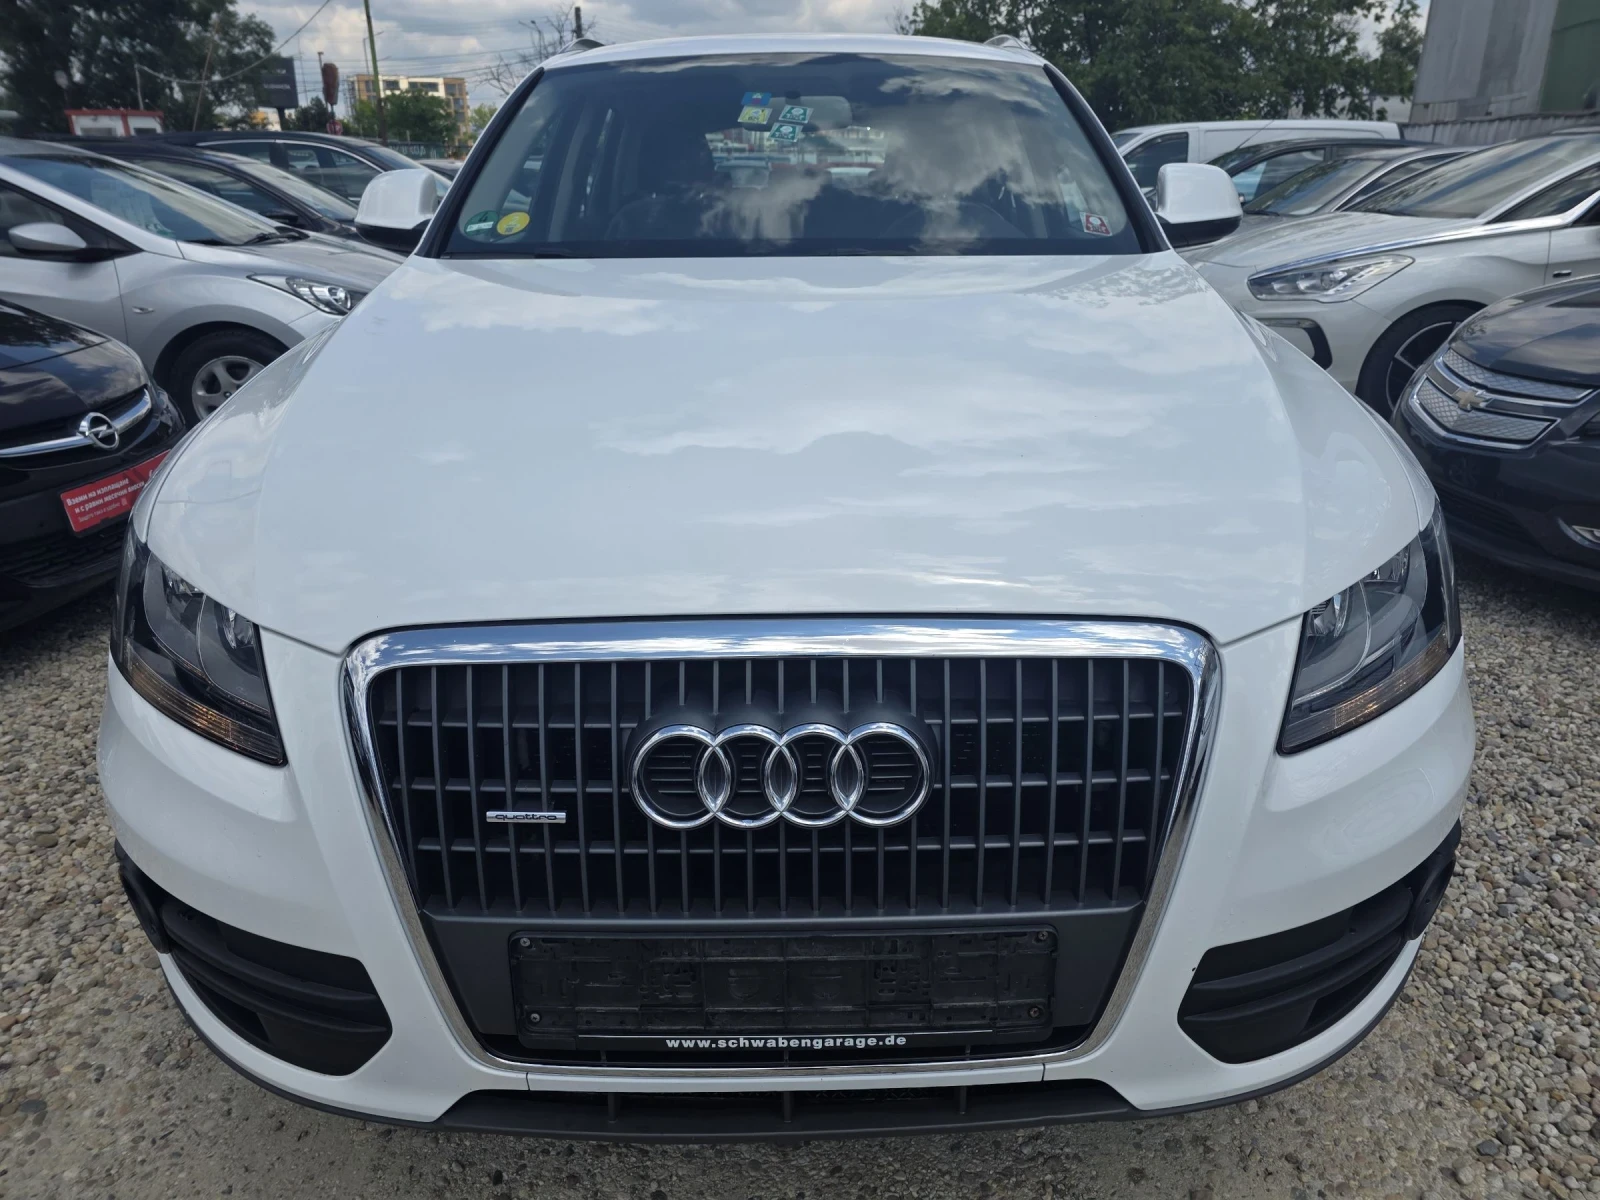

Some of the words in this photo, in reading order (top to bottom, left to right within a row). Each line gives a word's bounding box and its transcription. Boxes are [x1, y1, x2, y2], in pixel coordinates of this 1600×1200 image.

[66, 495, 88, 506] Вземи
[88, 490, 97, 498] на
[96, 478, 129, 496] изплащане
[85, 499, 104, 511] равни
[103, 490, 128, 503] месечни
[494, 813, 557, 821] quattro
[666, 1035, 907, 1049] www.schwabengarage.de
